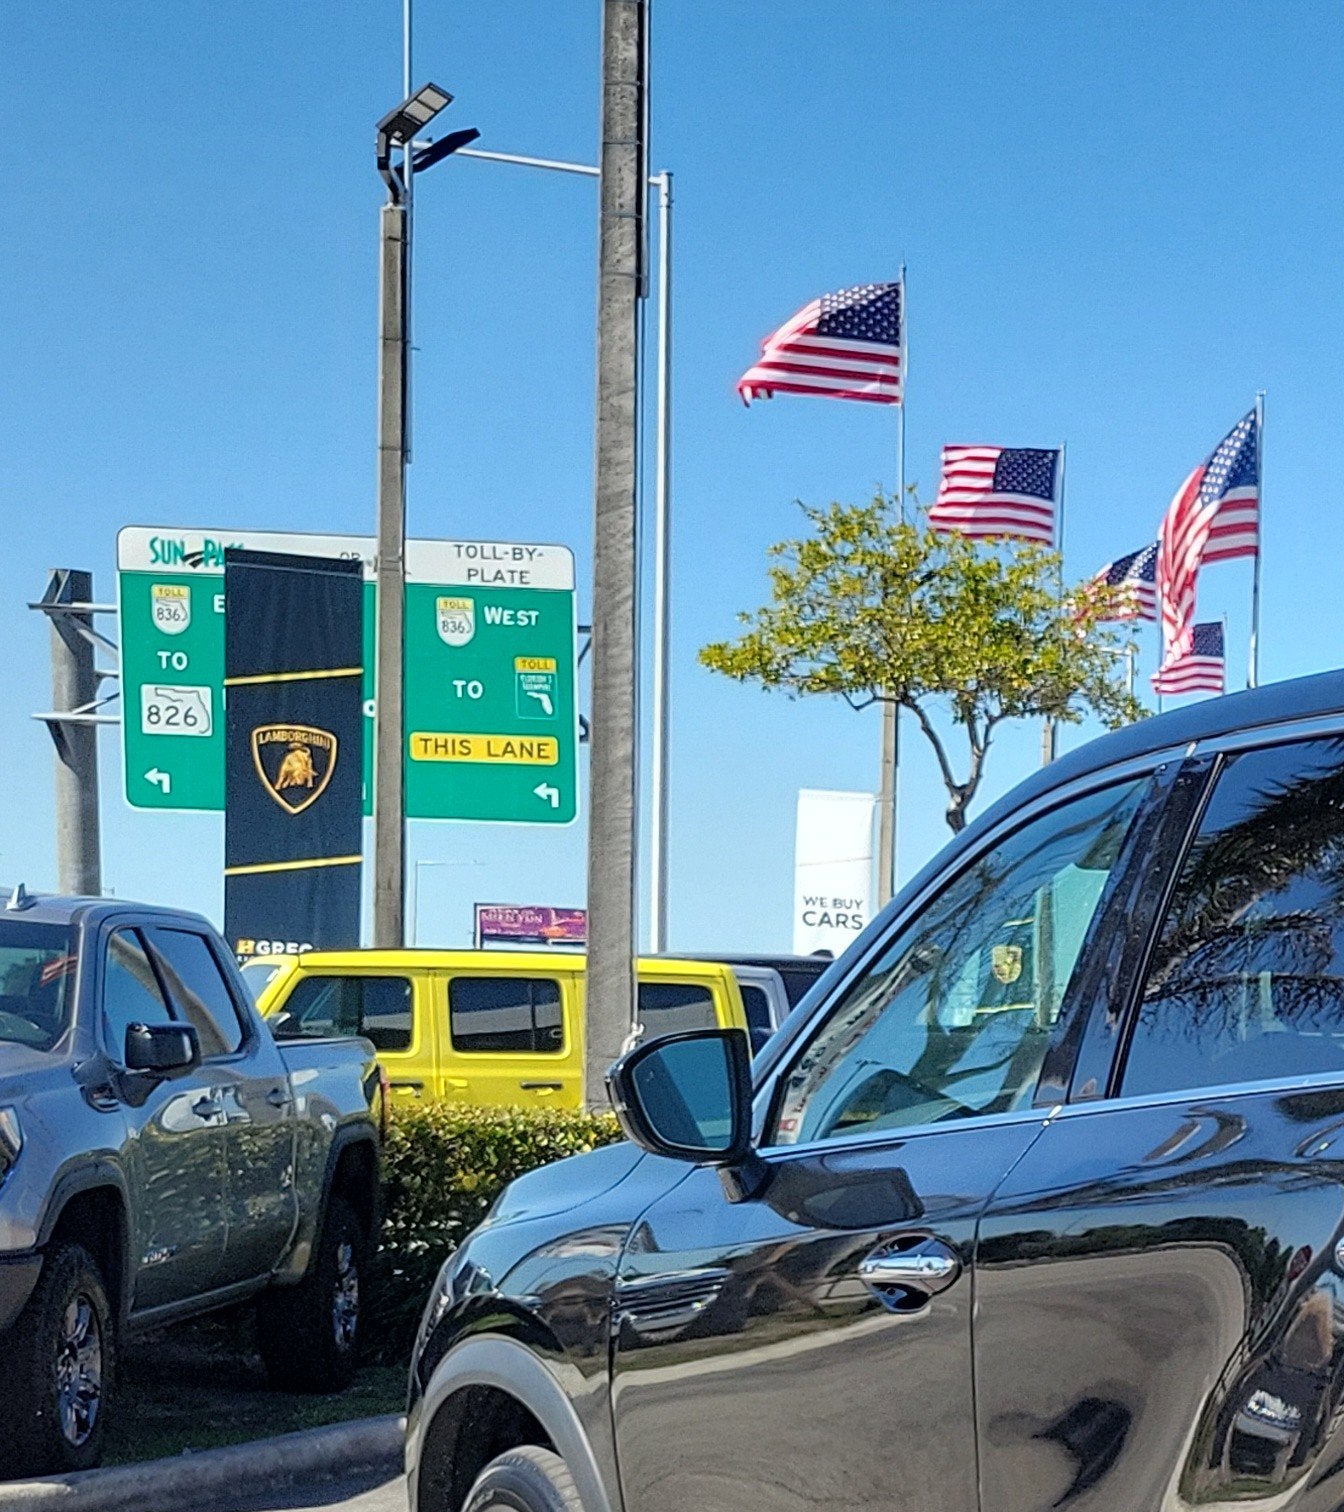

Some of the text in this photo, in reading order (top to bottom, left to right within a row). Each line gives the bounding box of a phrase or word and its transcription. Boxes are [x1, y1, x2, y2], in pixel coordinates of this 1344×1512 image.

[148, 536, 186, 566] SUN
[453, 543, 544, 562] TOLL-BY-
[467, 567, 531, 585] PLATE
[158, 587, 184, 597] TOLL
[156, 607, 181, 622] 836
[442, 601, 470, 610] TOLL
[483, 605, 541, 627] WEST
[441, 619, 466, 634] 836
[156, 650, 188, 671] TO
[520, 659, 551, 670] TOLL
[452, 679, 484, 699] TO
[146, 704, 198, 727] 826
[419, 737, 551, 760] THIS LANE
[802, 895, 864, 910] WE BUY
[801, 910, 864, 931] CARS
